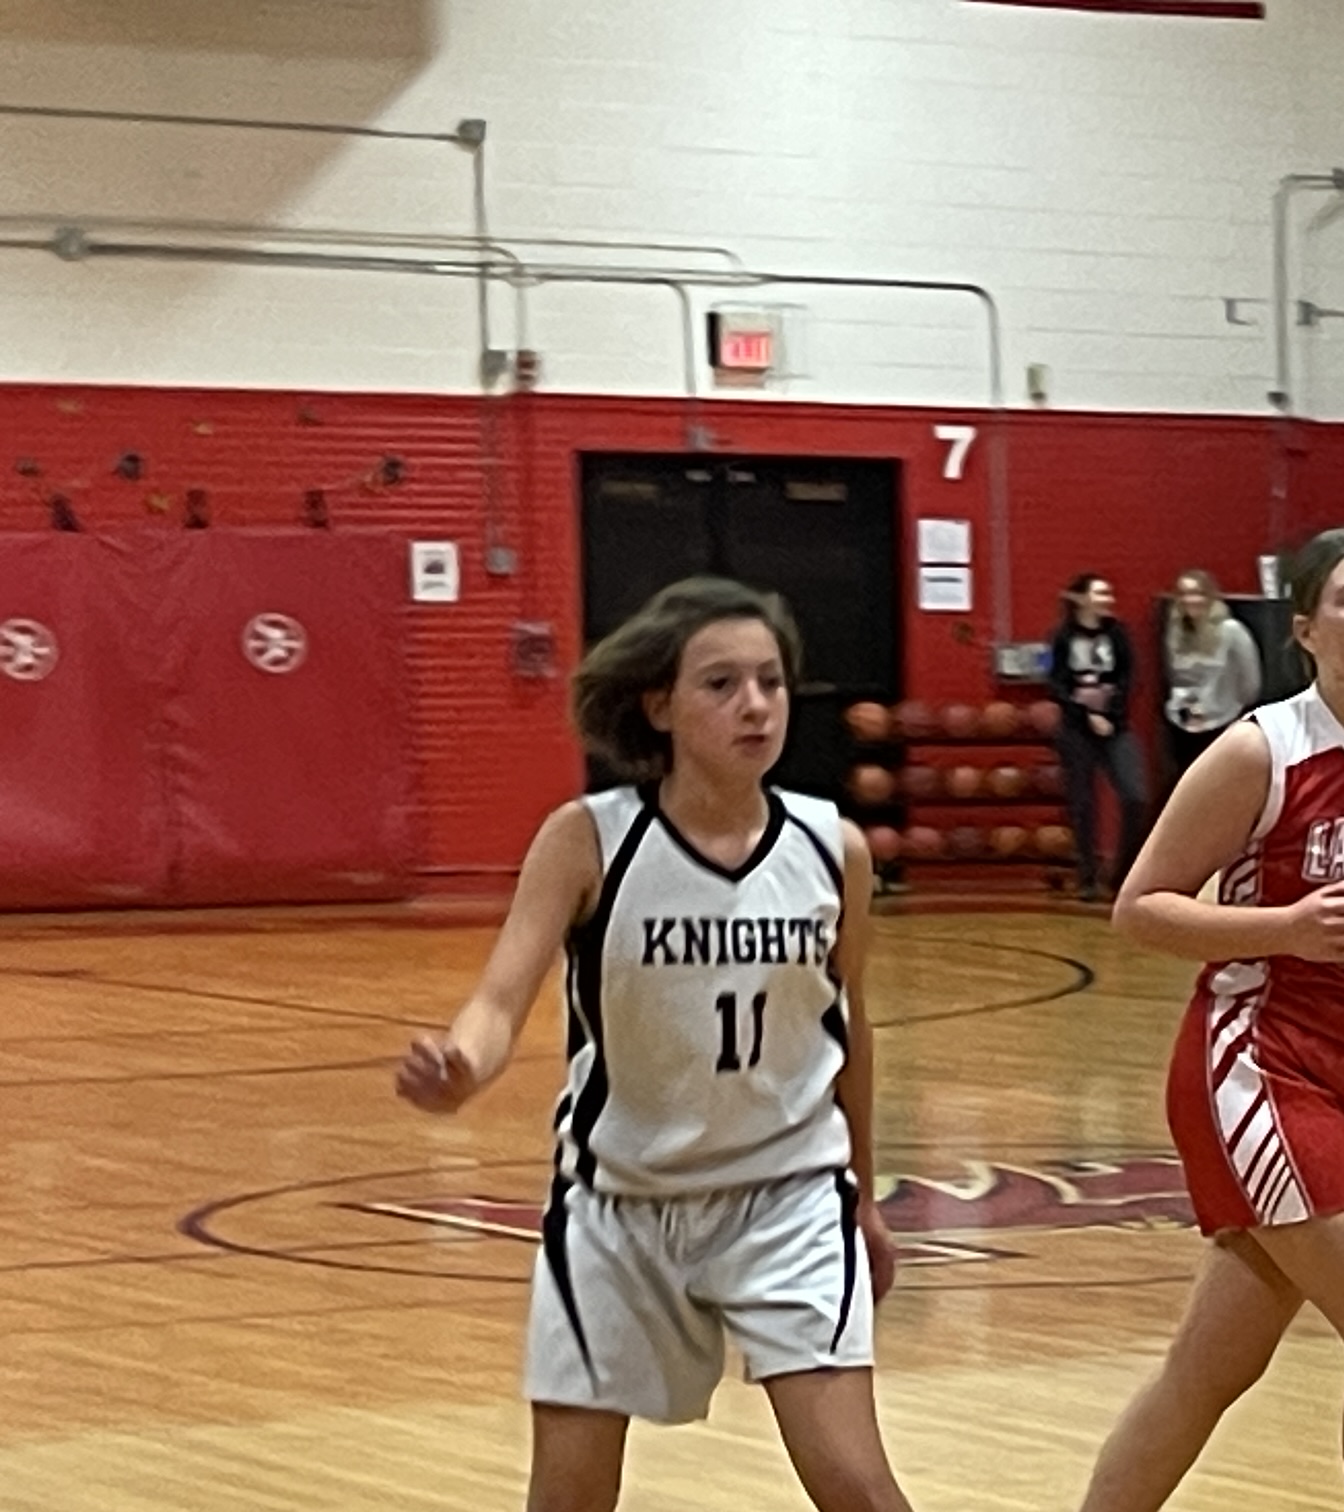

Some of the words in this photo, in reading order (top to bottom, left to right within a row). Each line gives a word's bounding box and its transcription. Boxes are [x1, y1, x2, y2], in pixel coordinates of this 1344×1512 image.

[933, 424, 977, 479] 7
[641, 916, 829, 967] KNIGHTS
[715, 991, 768, 1073] 11
